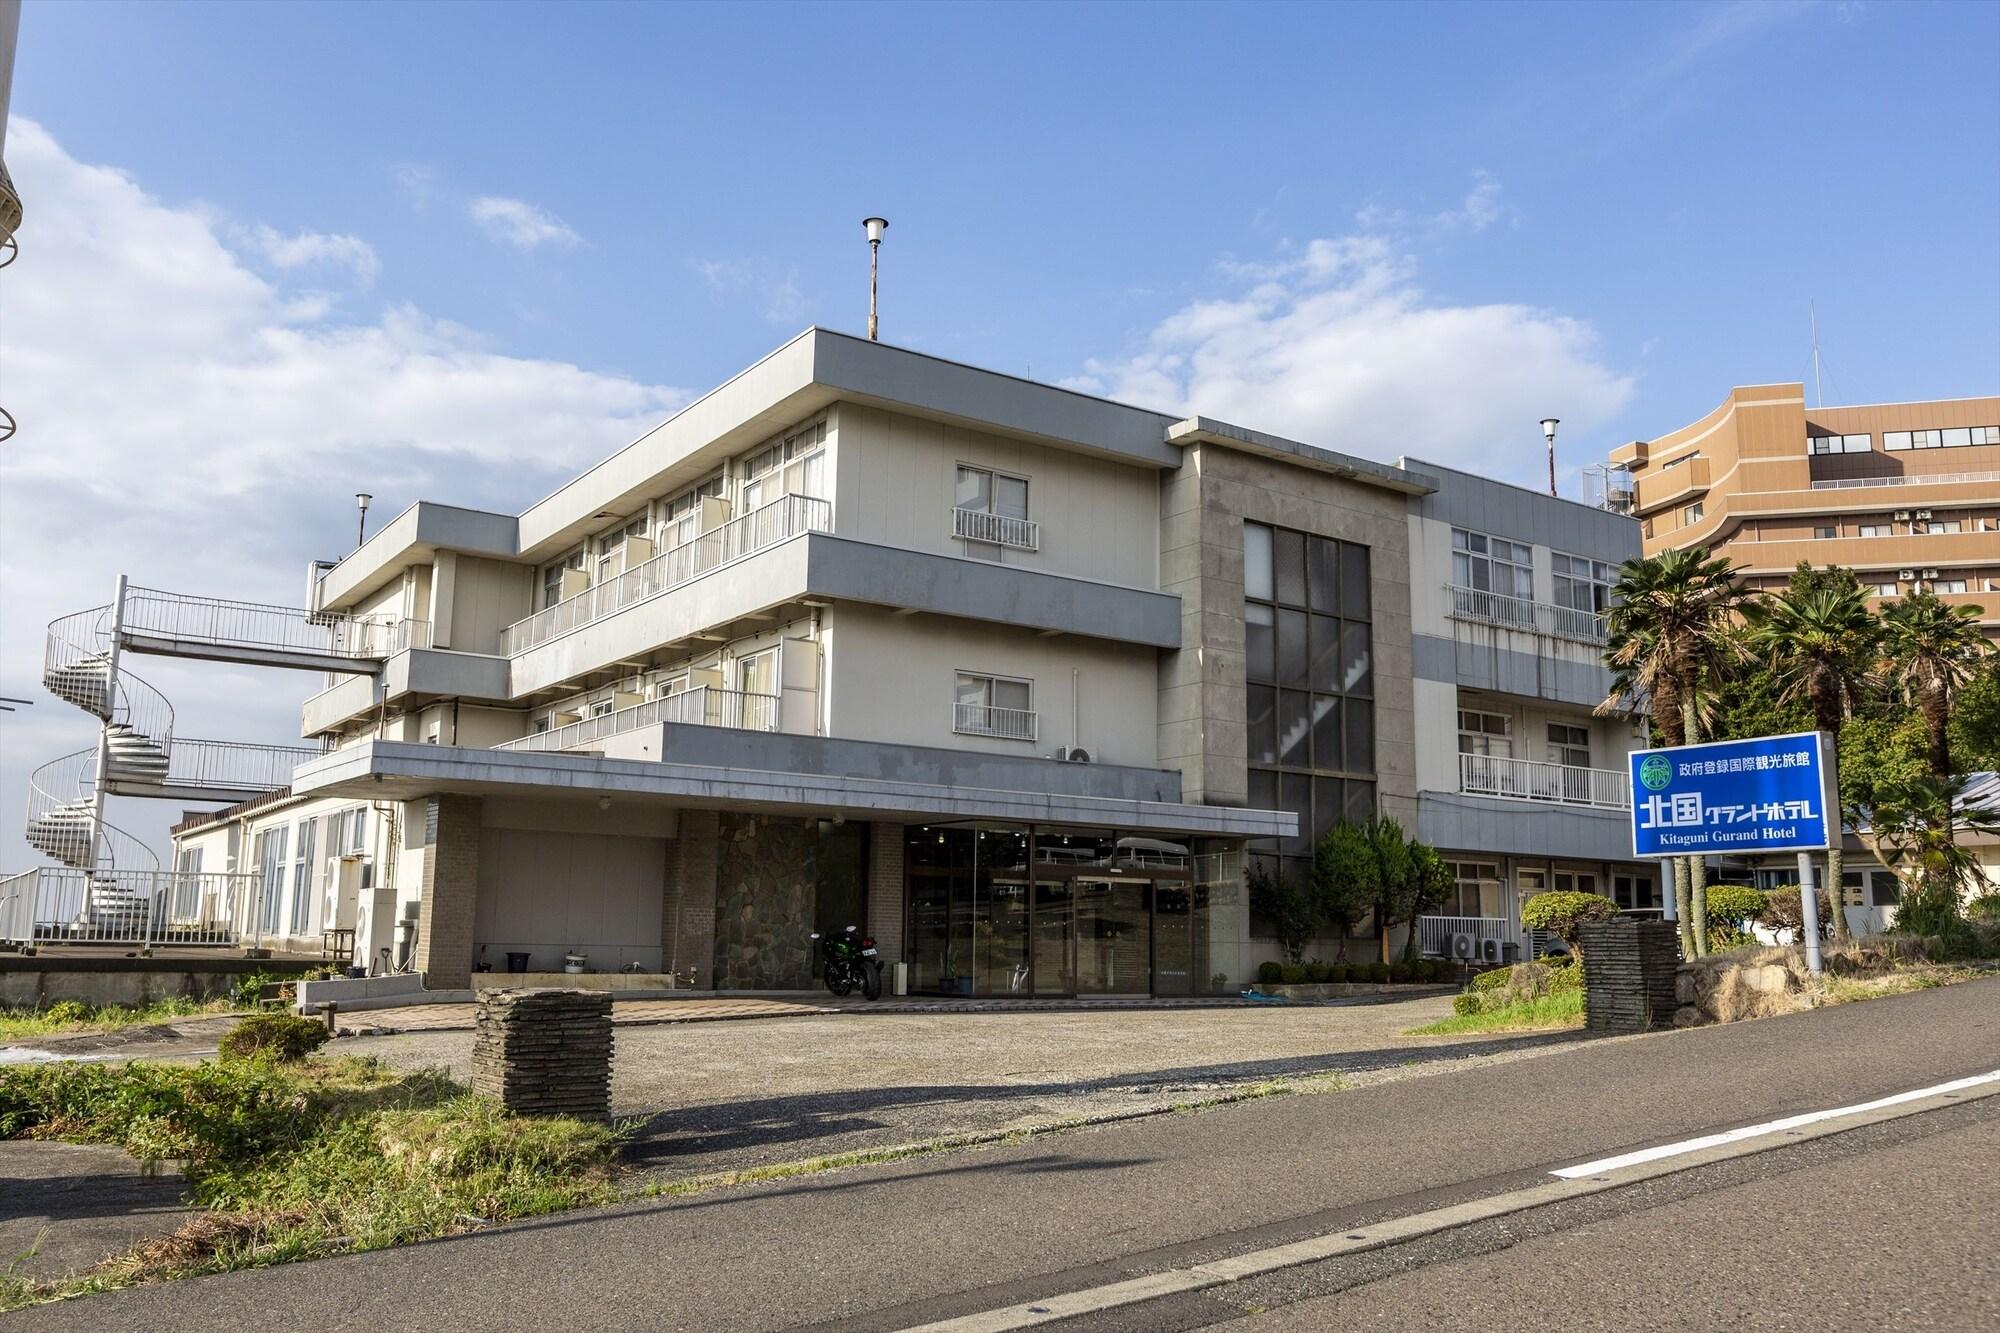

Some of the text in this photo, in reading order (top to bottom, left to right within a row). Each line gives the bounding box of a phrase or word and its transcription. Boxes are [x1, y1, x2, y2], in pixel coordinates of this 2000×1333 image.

[1679, 751, 1810, 776] 政府登録国際観光旅館
[1659, 826, 1796, 846] Kitaguni Gurand Hotel
